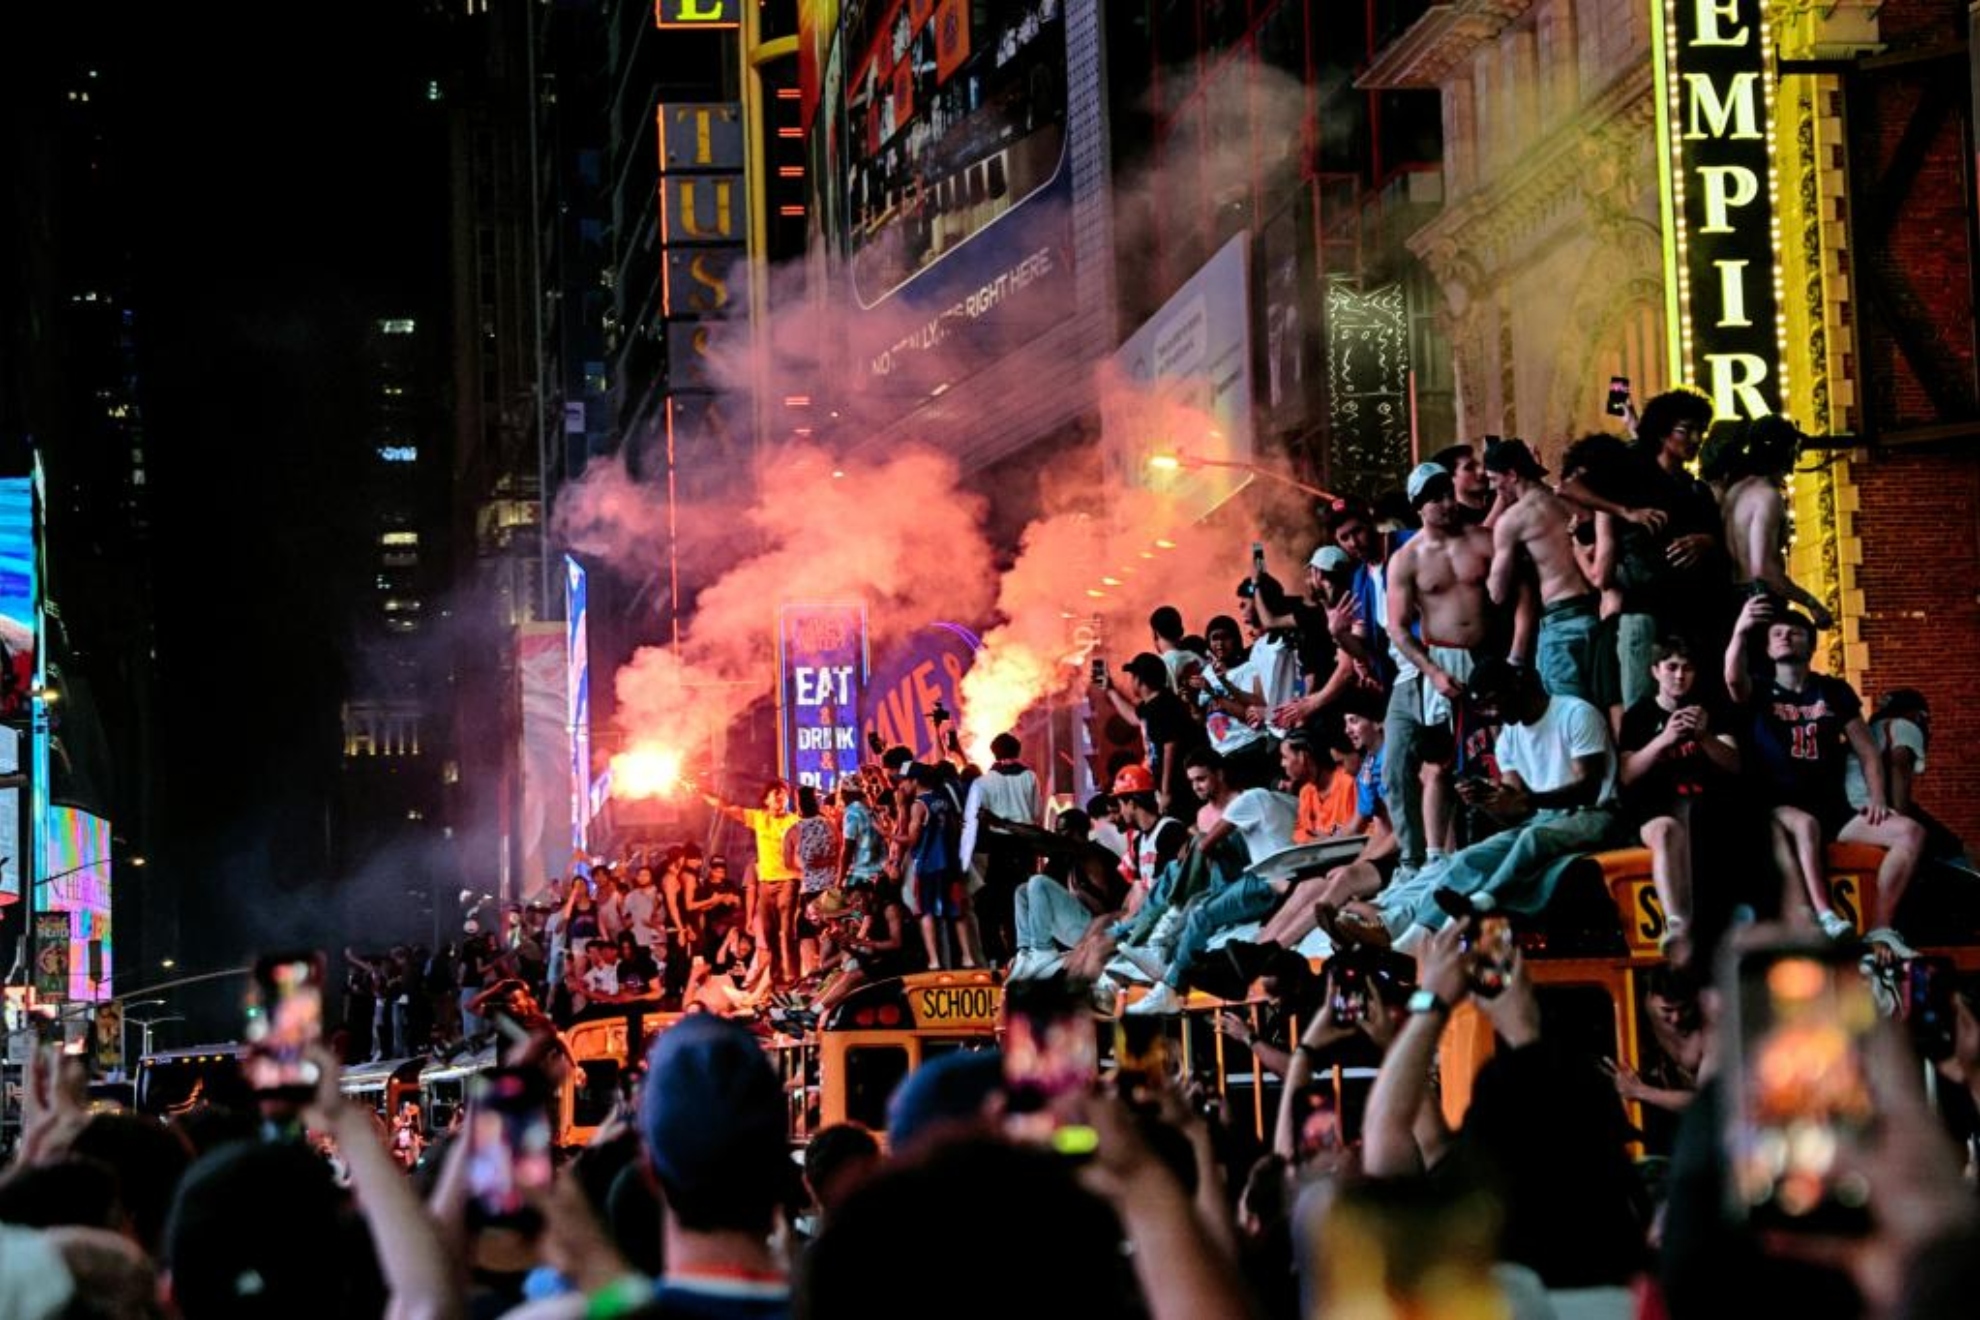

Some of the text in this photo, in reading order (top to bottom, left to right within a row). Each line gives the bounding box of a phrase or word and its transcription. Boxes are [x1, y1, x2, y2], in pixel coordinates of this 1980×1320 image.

[1683, 0, 1772, 421] EMPIR
[965, 274, 1008, 318] RIGHT
[796, 666, 853, 705] EAT
[798, 727, 855, 750] DRINK
[1791, 722, 1819, 760] 11
